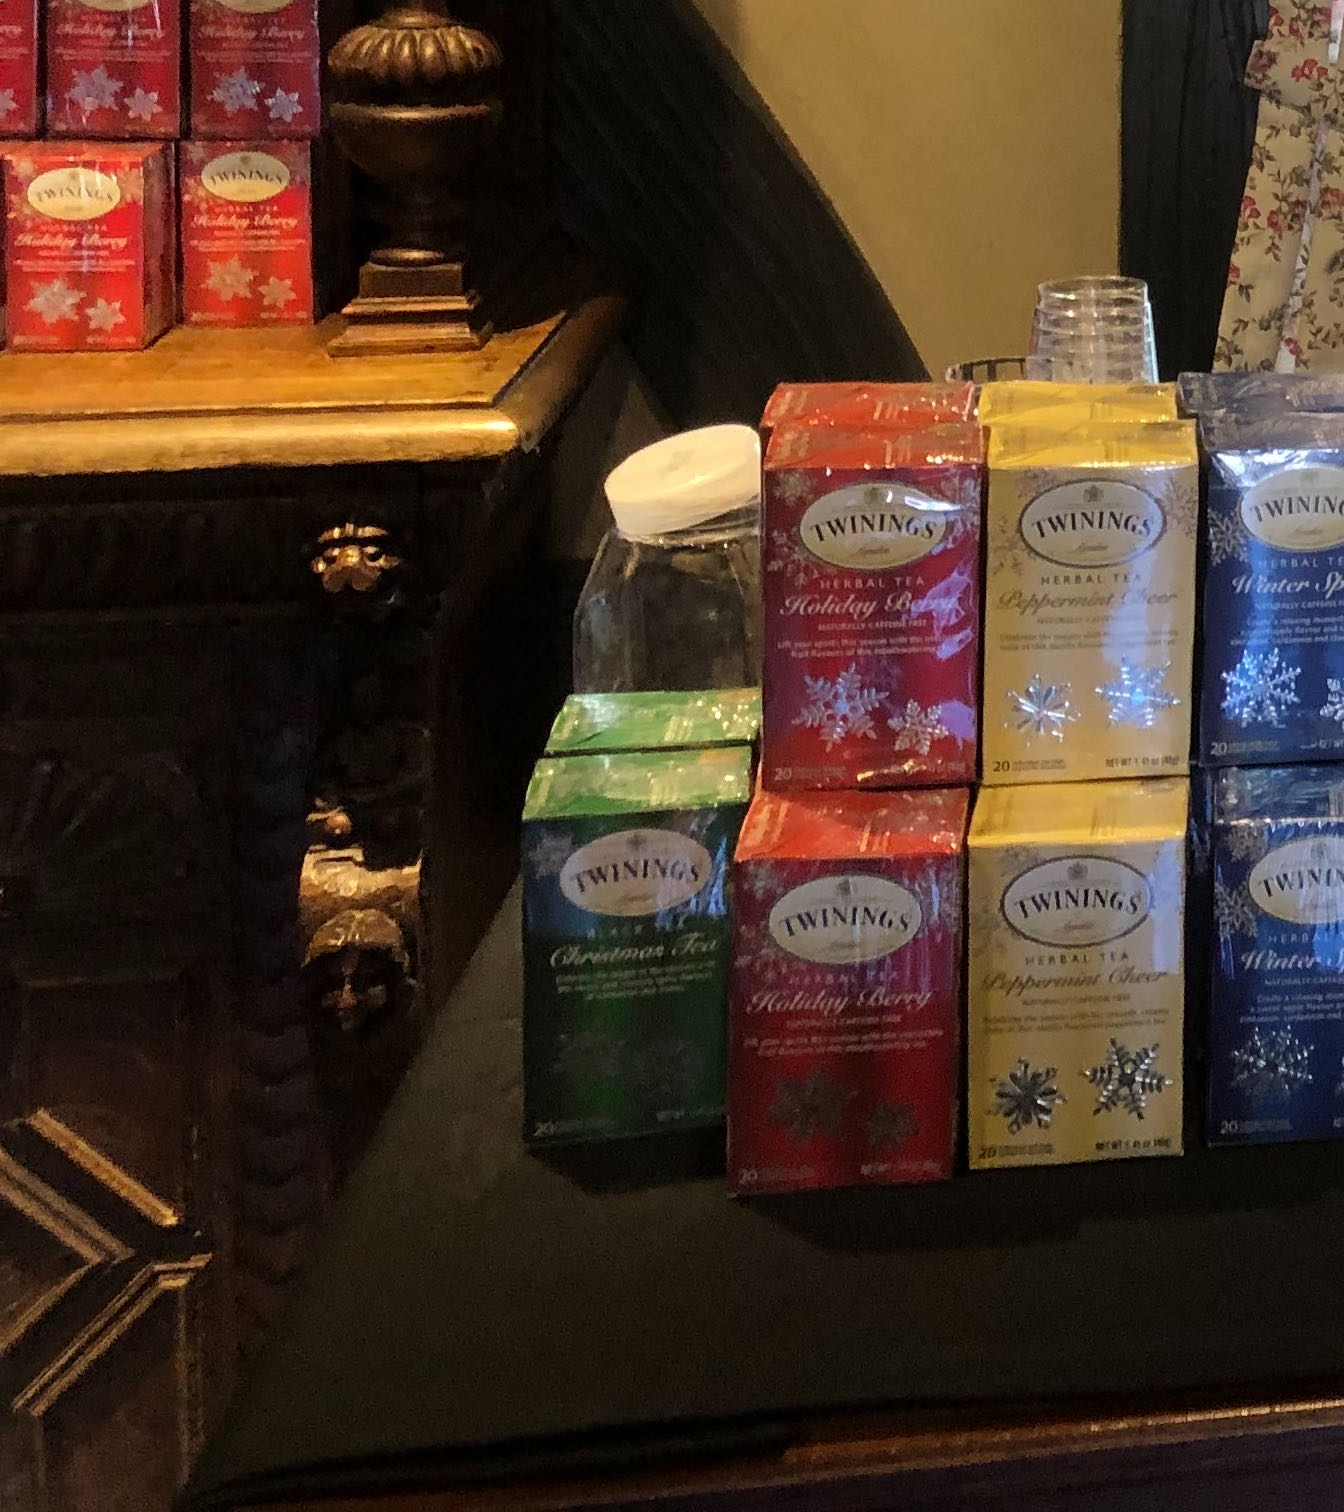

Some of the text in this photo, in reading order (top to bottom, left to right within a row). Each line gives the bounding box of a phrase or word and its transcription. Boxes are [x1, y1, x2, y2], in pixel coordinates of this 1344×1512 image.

[809, 513, 937, 543] TWININGS
[1032, 511, 1155, 539] TWININGS
[1259, 557, 1319, 569] HERBAL
[820, 577, 925, 590] HERBAL TEA
[1040, 575, 1103, 586] HERBAL
[1231, 574, 1310, 594] Winter
[779, 594, 877, 620] Holiday
[996, 587, 1115, 617] Peppermint
[1211, 741, 1228, 756] 20
[993, 761, 1011, 772] 20
[570, 859, 699, 893] TWININGS
[1014, 888, 1142, 919] TWININGS
[778, 907, 912, 937] TWININGS
[1025, 952, 1129, 966] HERBAL TEA
[1240, 949, 1321, 971] Winter
[983, 964, 1168, 997] Peppermint Cheer
[745, 985, 933, 1017] Holiday Berry
[1220, 1120, 1239, 1134] 20
[979, 1146, 997, 1159] 20
